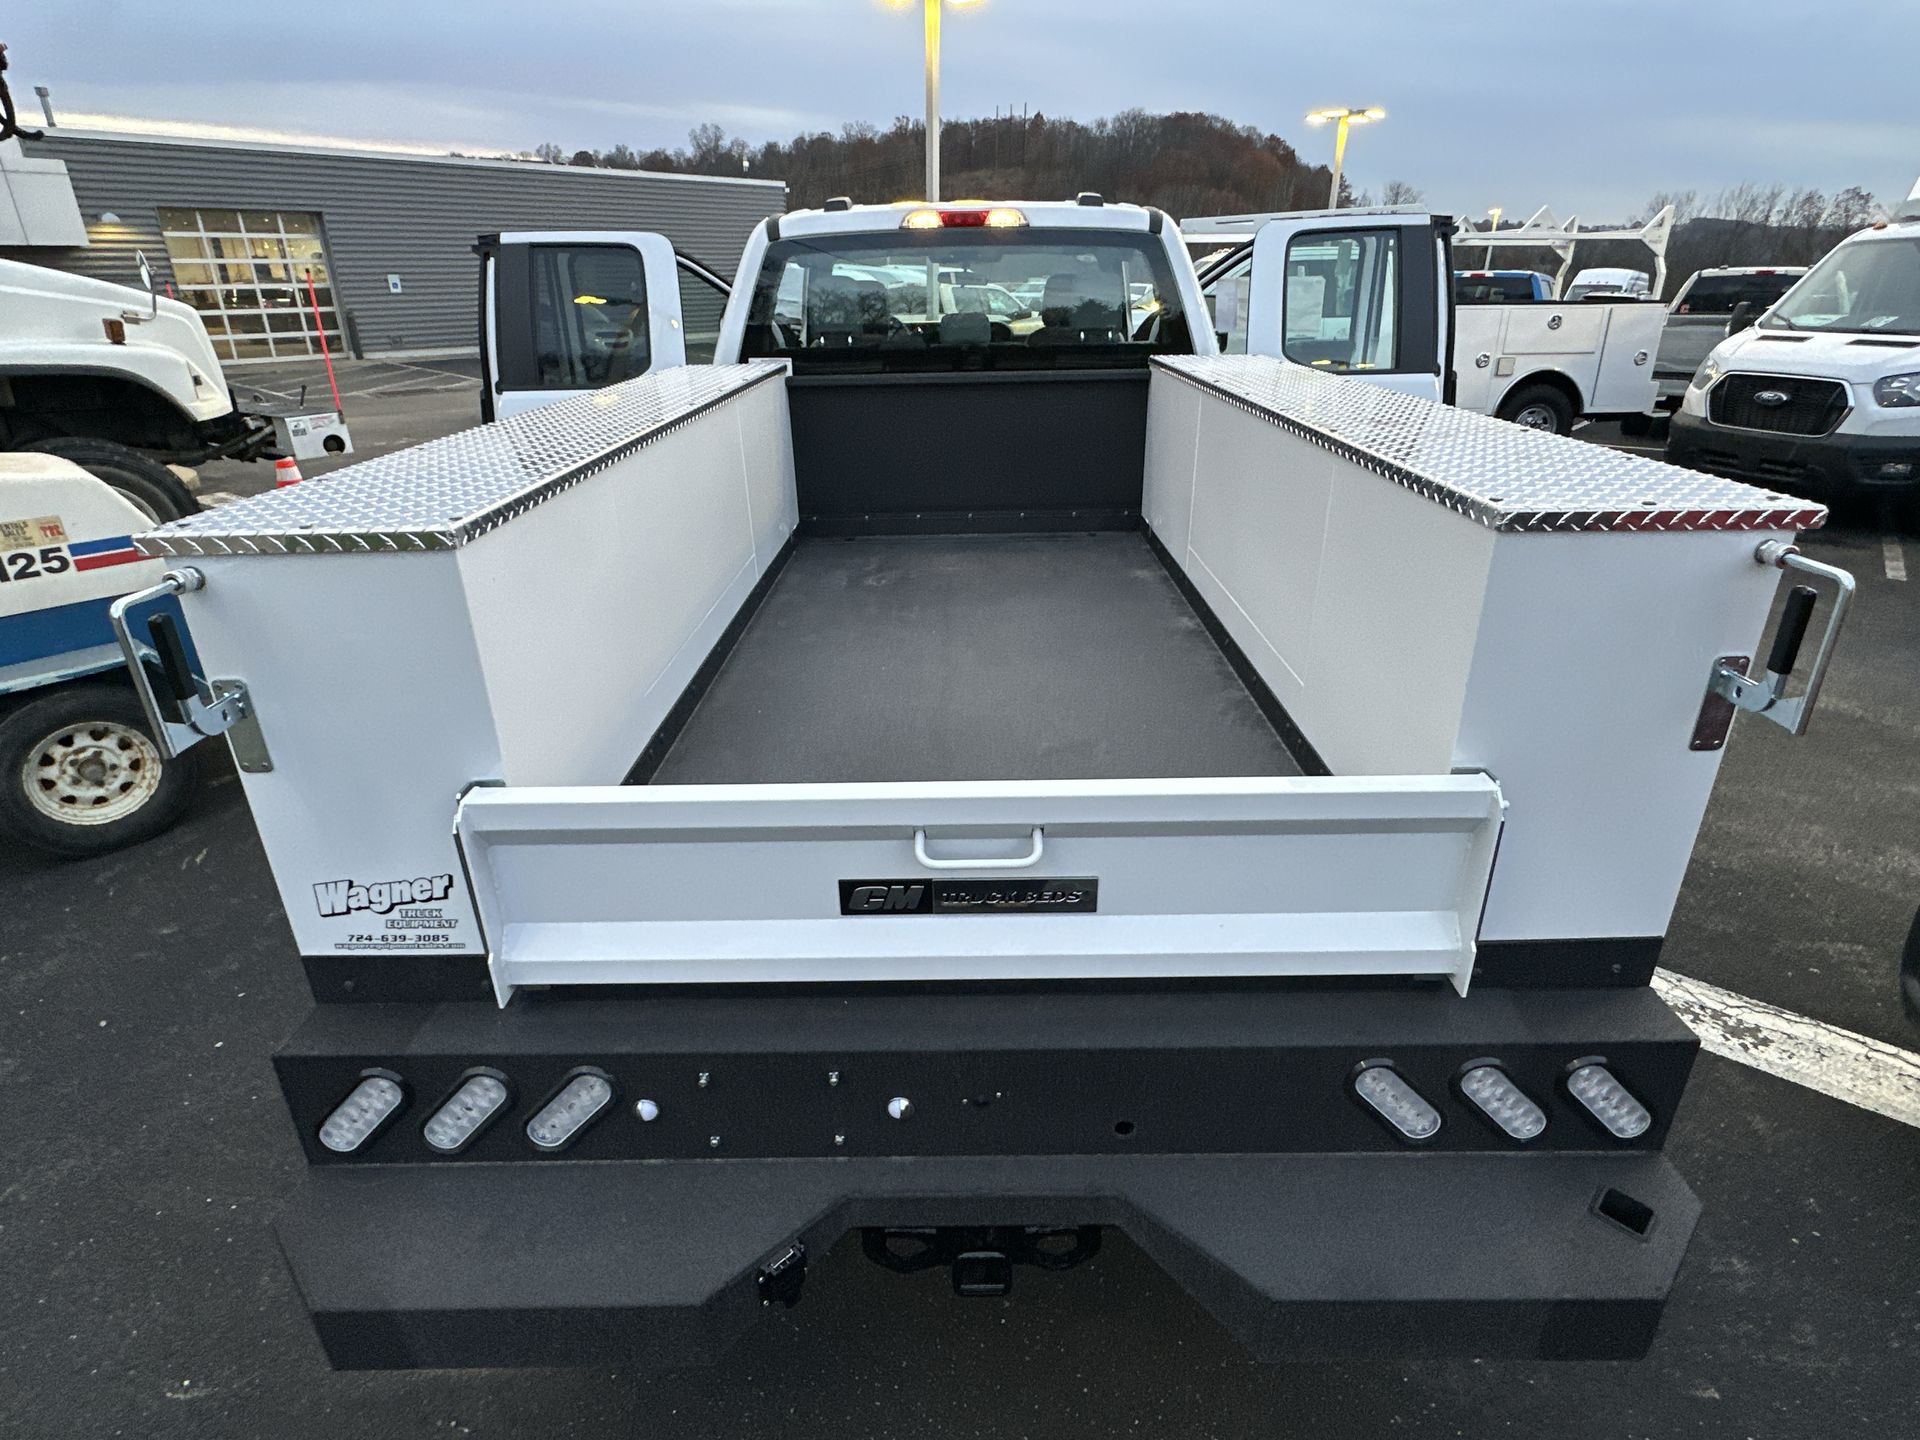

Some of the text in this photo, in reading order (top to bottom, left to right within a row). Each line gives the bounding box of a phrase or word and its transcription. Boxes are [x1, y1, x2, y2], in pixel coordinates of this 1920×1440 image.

[313, 874, 454, 918] Wagner
[941, 891, 1020, 905] TRUCK
[1024, 891, 1083, 904] BEDS
[399, 908, 443, 918] TRUCK
[385, 919, 458, 929] EQUIPMENT
[347, 934, 450, 943] 724-639-3085
